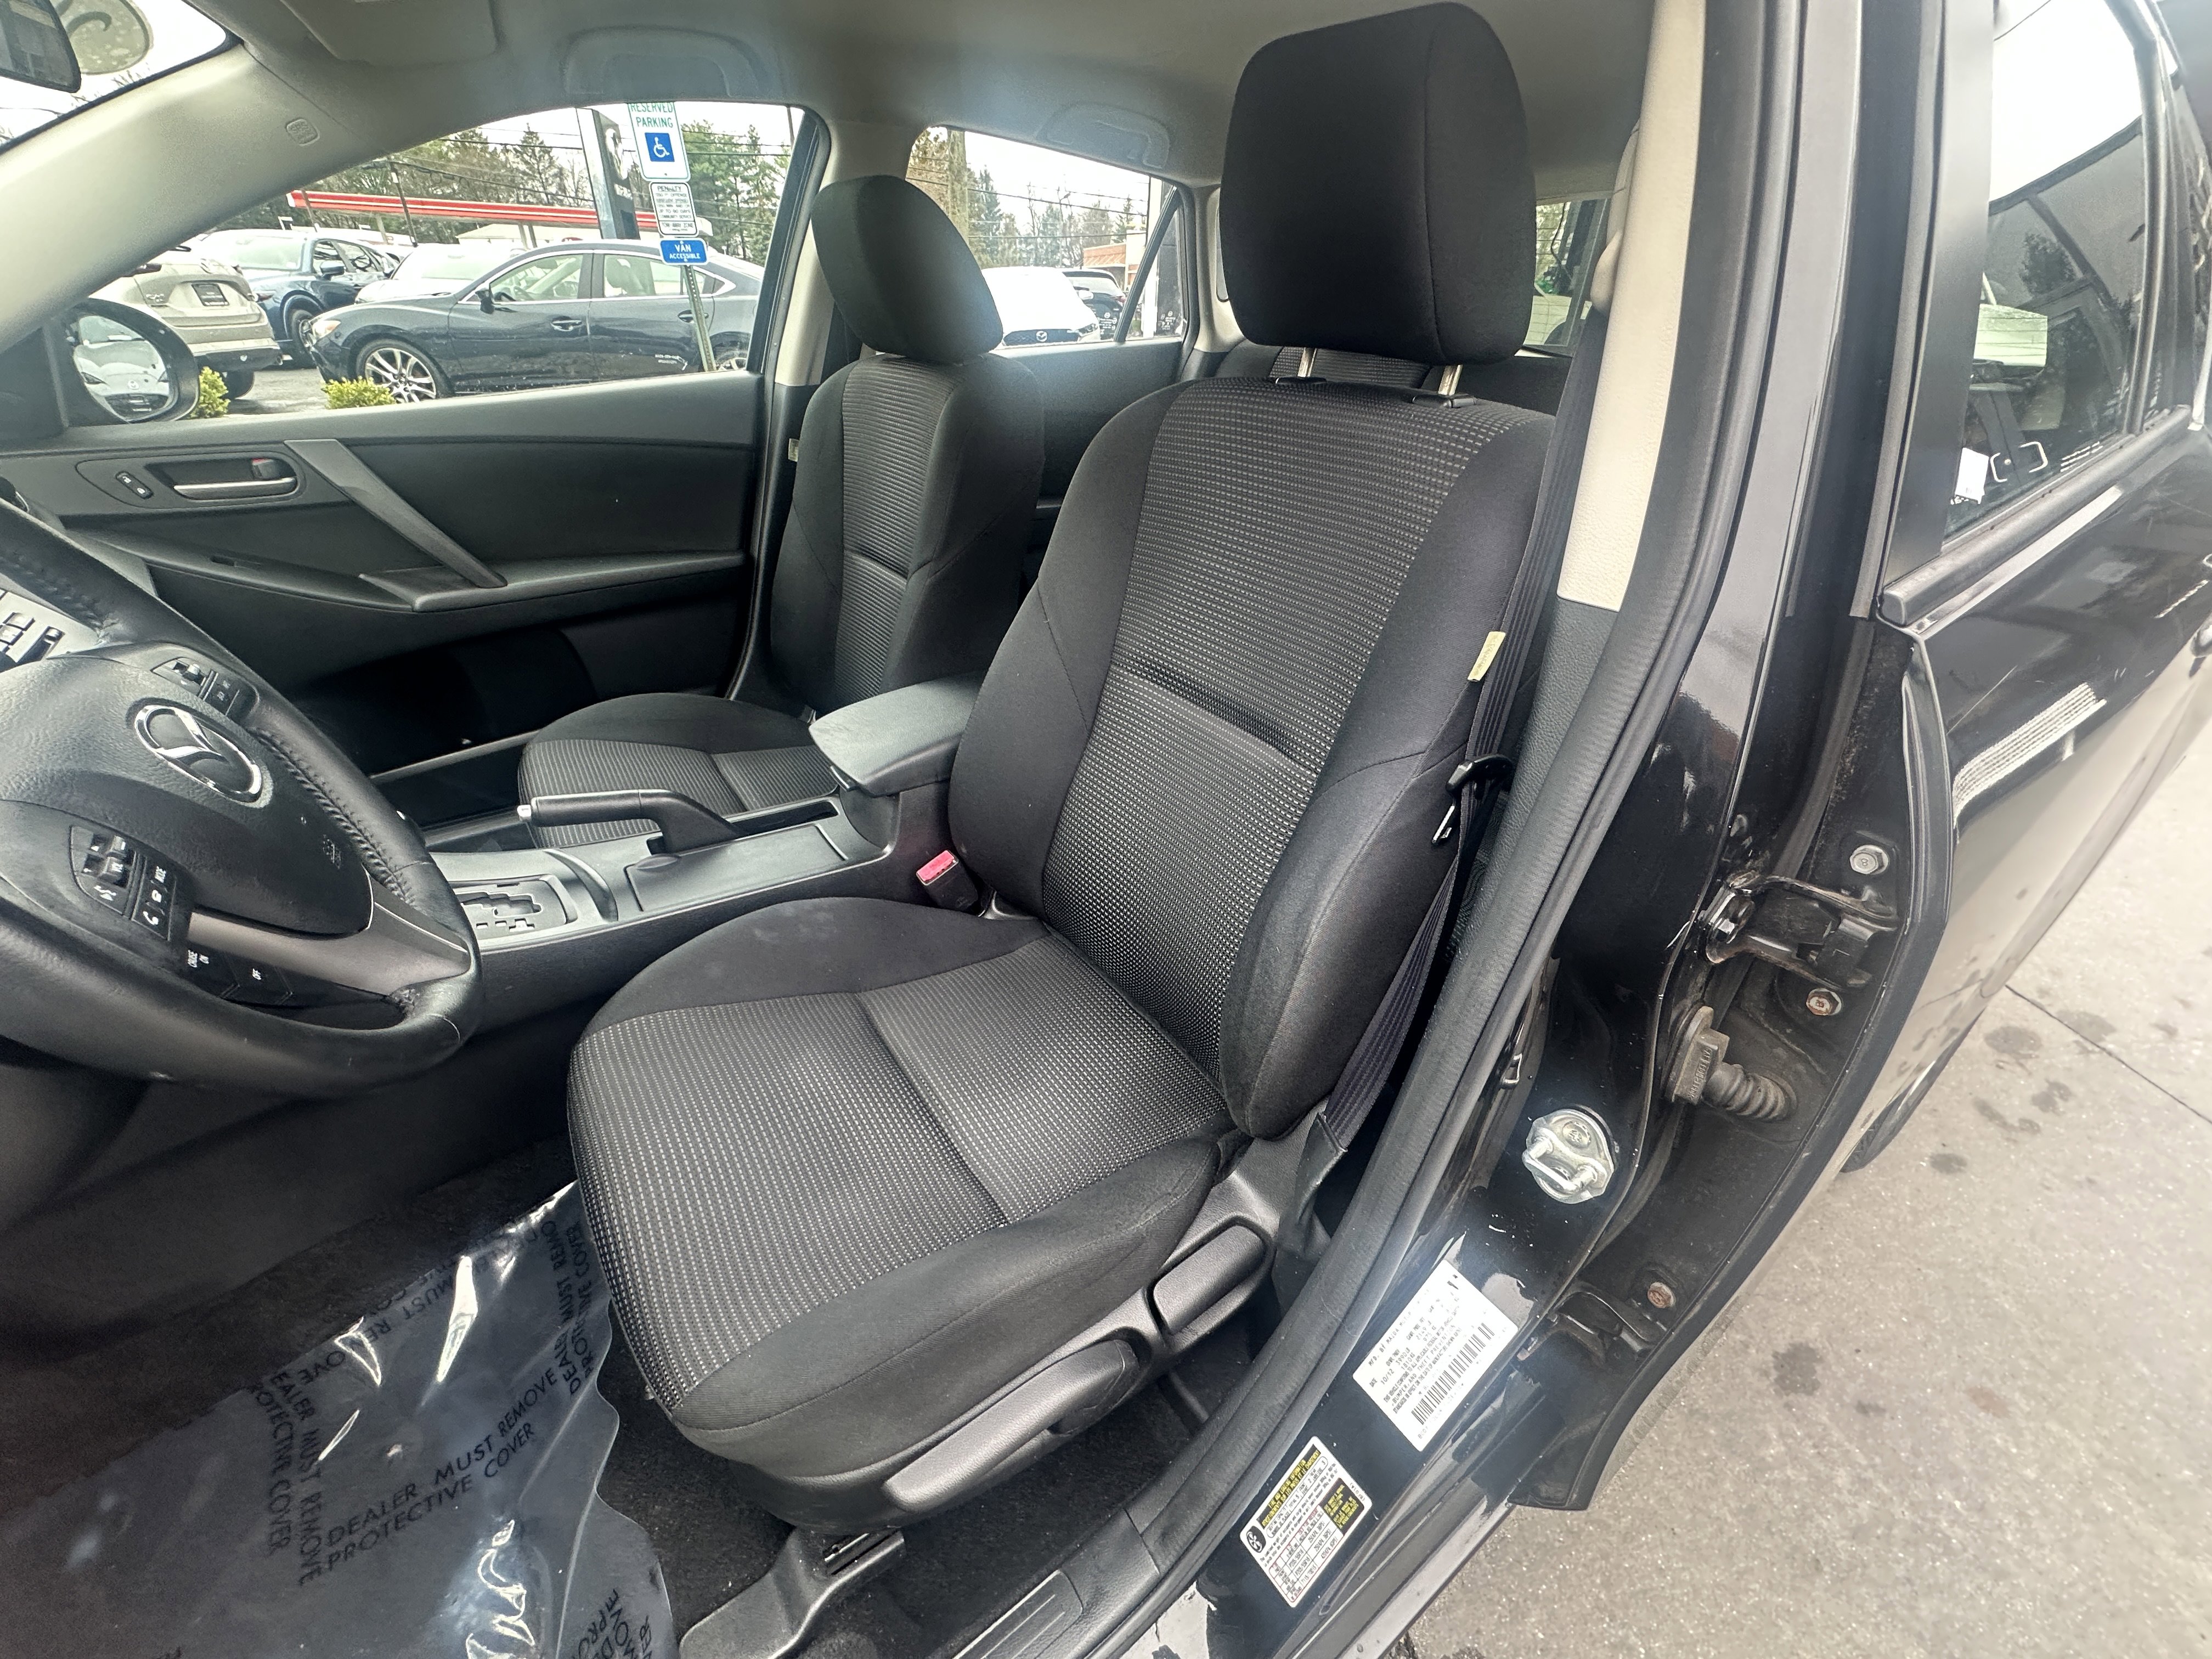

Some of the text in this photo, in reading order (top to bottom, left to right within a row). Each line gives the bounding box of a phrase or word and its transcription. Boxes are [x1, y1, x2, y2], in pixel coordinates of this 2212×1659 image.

[630, 103, 673, 113] RESERVED
[636, 117, 673, 128] PARKING
[674, 244, 692, 252] VAN
[199, 953, 210, 964] ON
[252, 968, 262, 980] OFF
[540, 1221, 567, 1271] REMO
[404, 1274, 454, 1321] MUST
[556, 1277, 574, 1322] MUST
[1423, 1331, 1431, 1342] 975
[1368, 1353, 1379, 1366] MFD.
[1378, 1342, 1386, 1352] BY
[1385, 1327, 1399, 1344] MAZDA
[1417, 1355, 1431, 1371] THEFT
[1369, 1378, 1378, 1387] DATE
[1380, 1368, 1394, 1385] 10/12
[1388, 1384, 1398, 1396] VEHICLE
[1392, 1396, 1407, 1413] STANDARDS
[1407, 1384, 1416, 1395] EFFECT
[328, 1368, 558, 1548] DEALER MUST REMOVE
[255, 1390, 294, 1556] OTECTIVE COVER
[1289, 1458, 1306, 1480] INFORMATION
[270, 1372, 323, 1587] EALER MUST REMOVE
[328, 1421, 537, 1572] PROTECTIVE COVER
